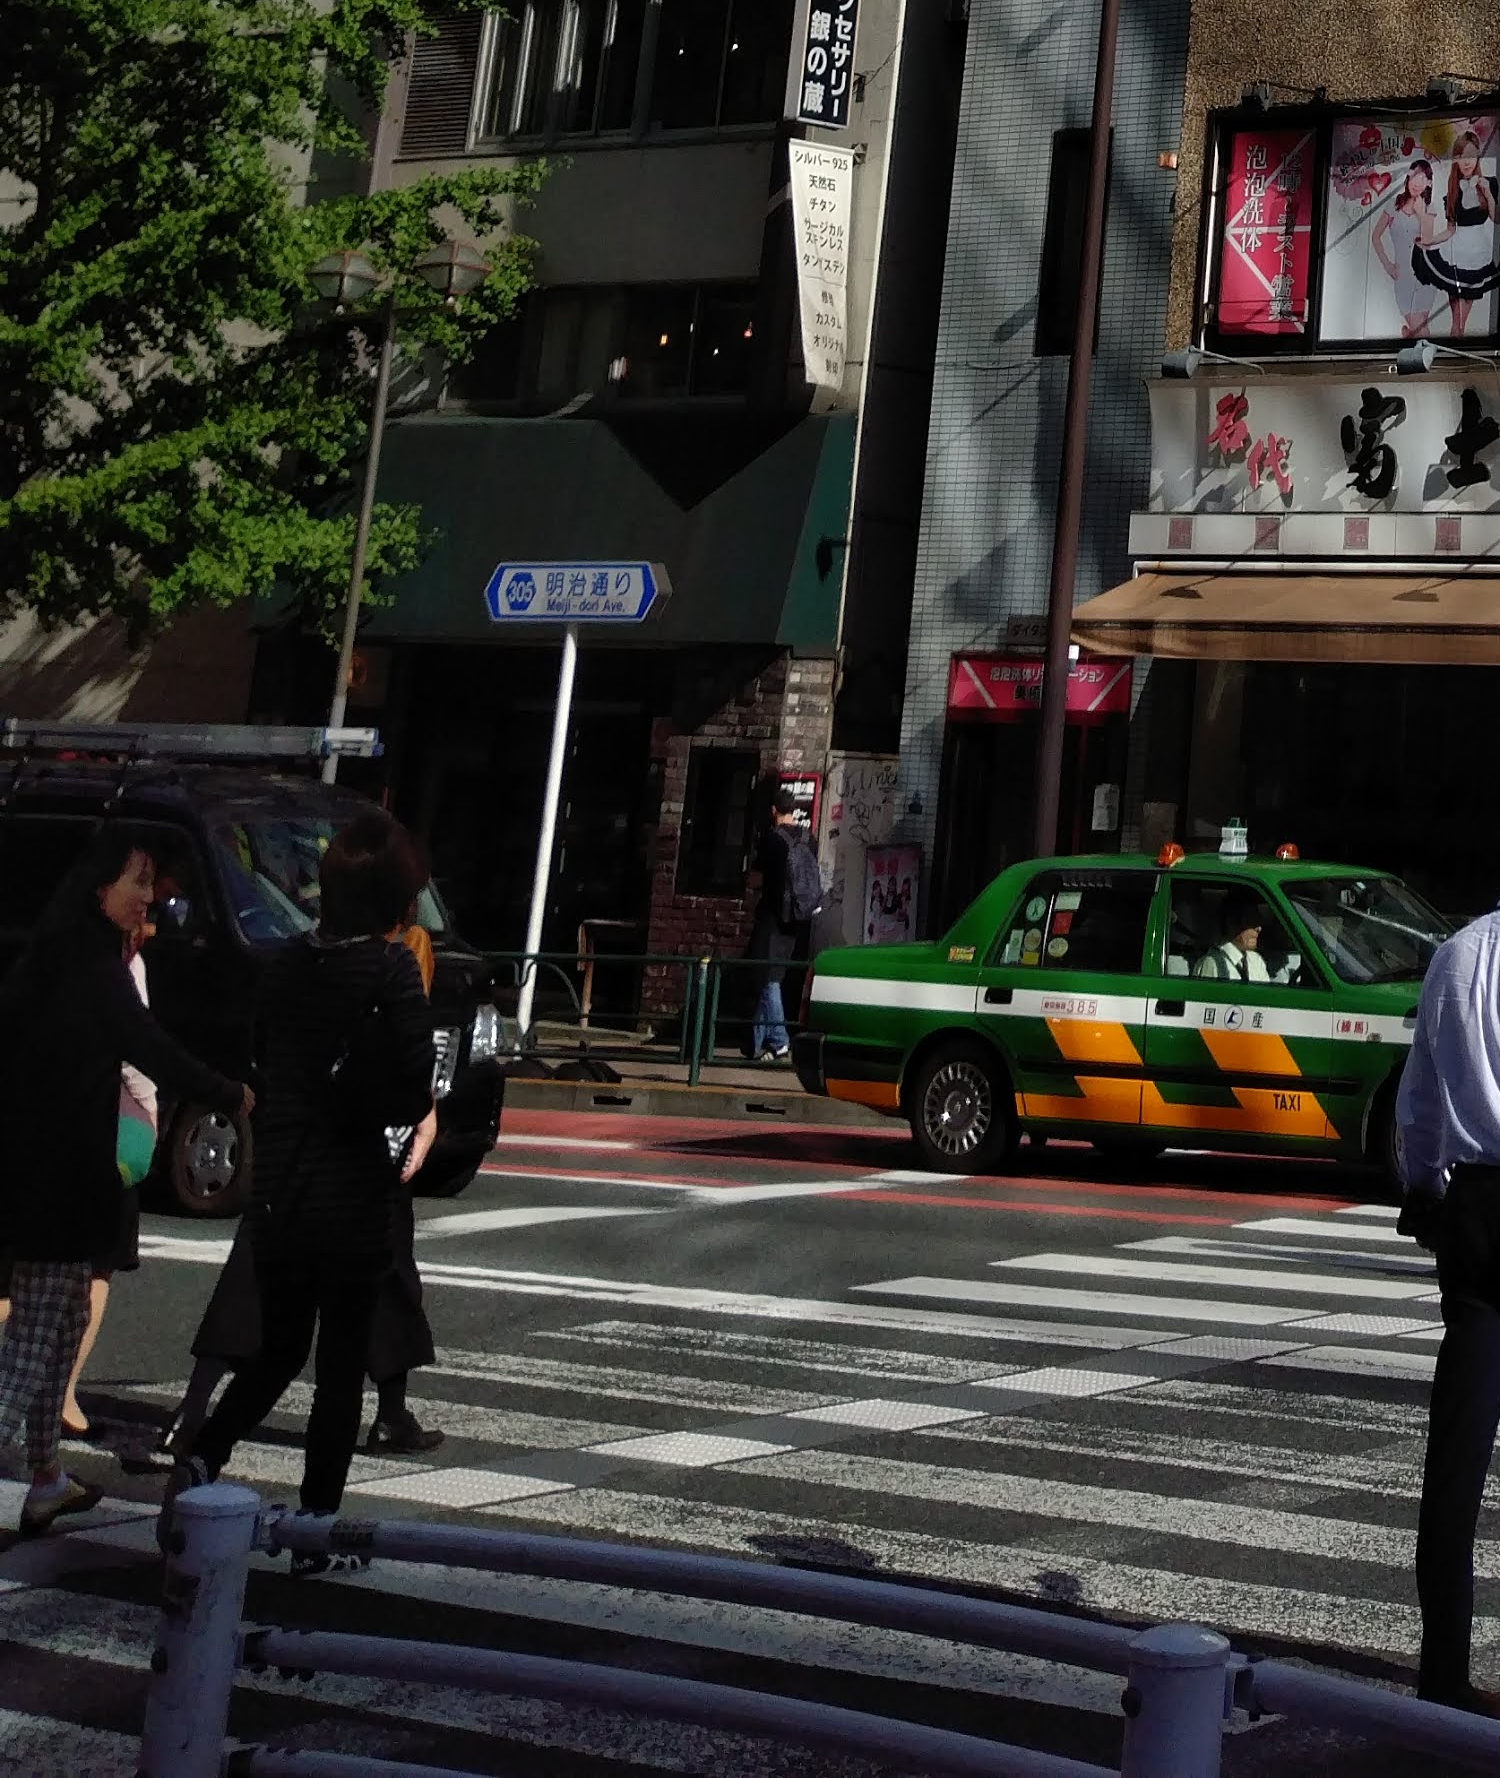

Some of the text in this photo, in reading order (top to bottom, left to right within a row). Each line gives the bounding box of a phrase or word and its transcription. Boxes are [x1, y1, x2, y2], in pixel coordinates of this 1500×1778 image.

[803, 9, 831, 114] 銀の蔵
[794, 149, 849, 171] シルバー 925
[808, 174, 837, 193] 天然石
[809, 197, 837, 214] チタン
[1239, 145, 1267, 255] 泡泡洗体
[507, 580, 536, 603] 305
[545, 572, 632, 599] 明治通り
[546, 598, 627, 614] Meiji-dori Ave.
[1272, 1093, 1301, 1112] TAXI
